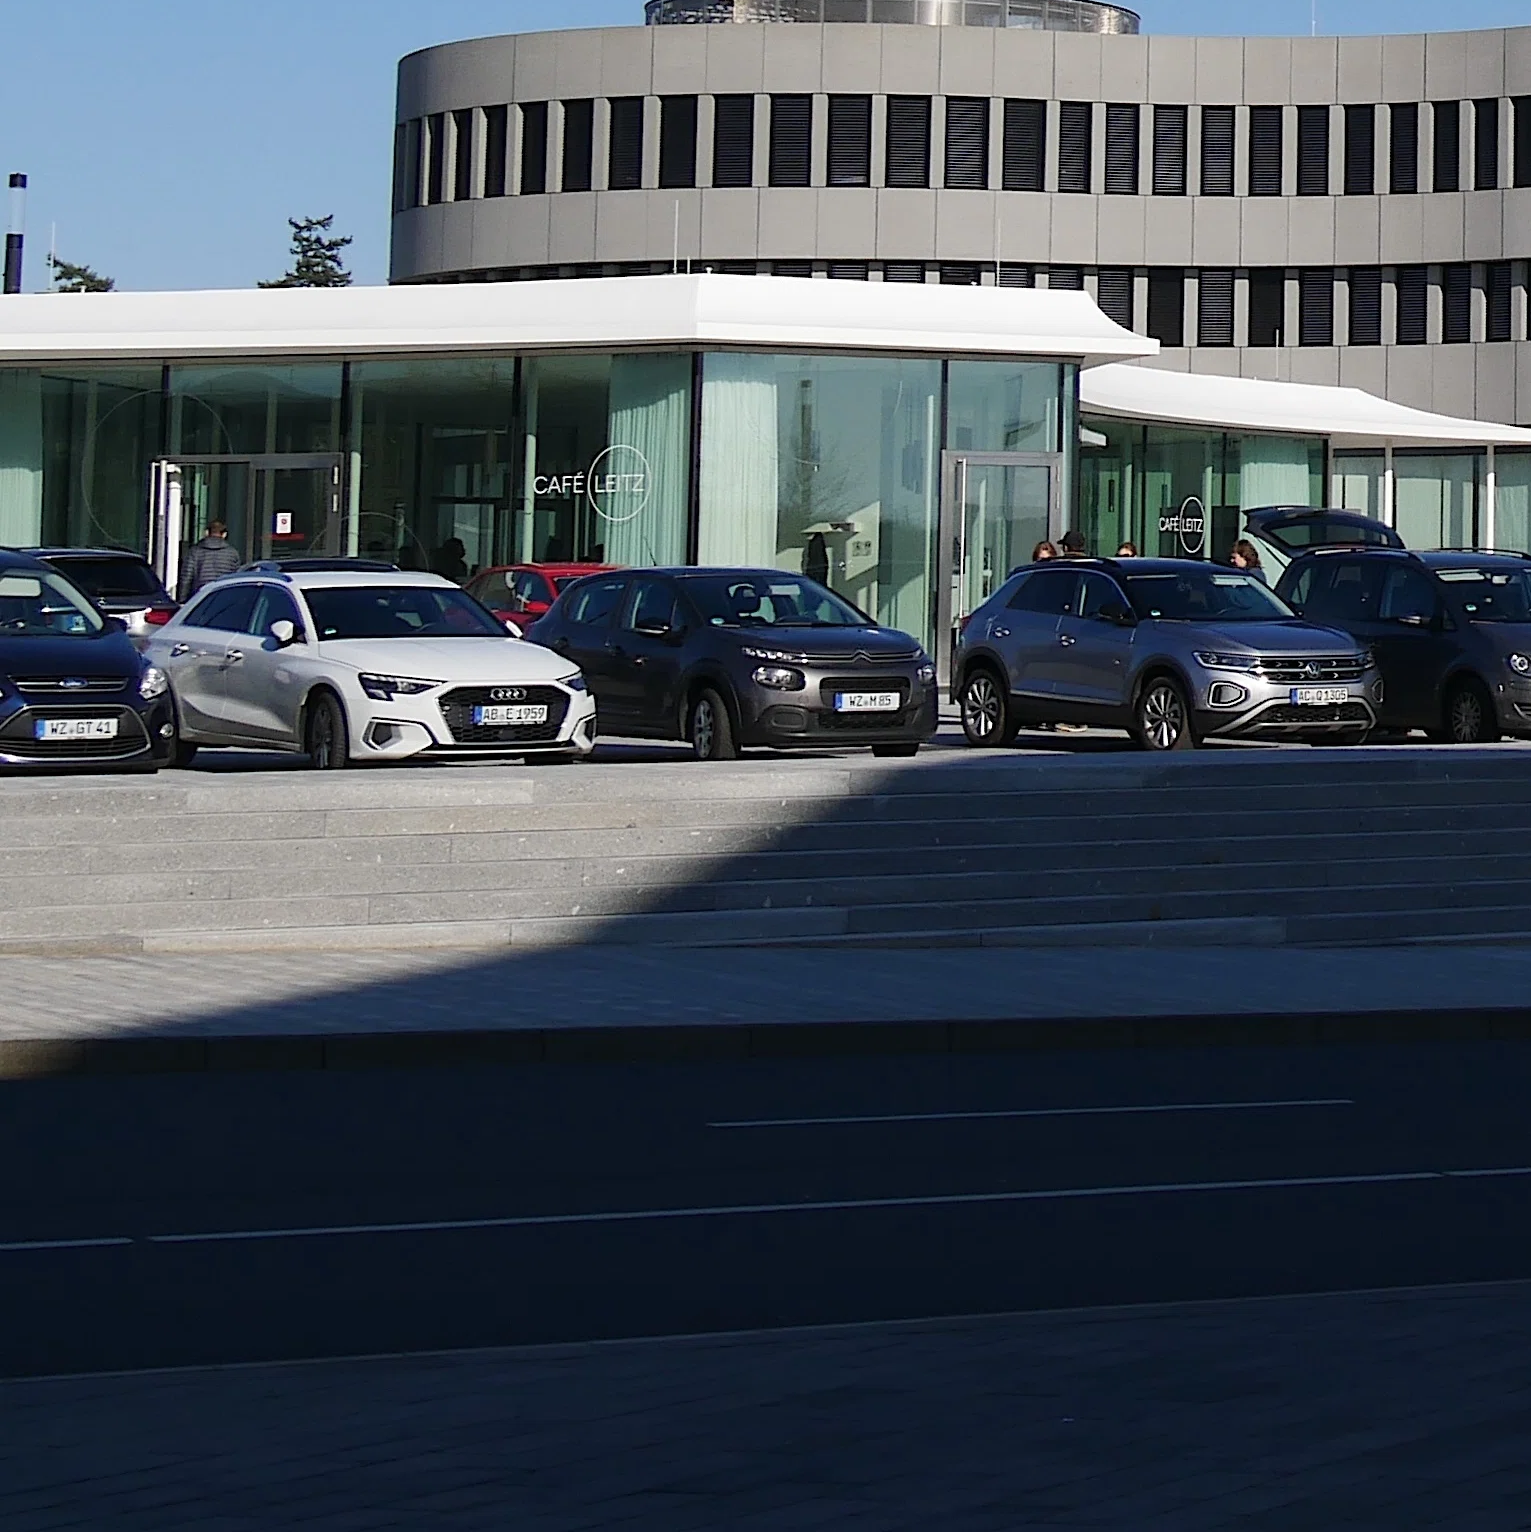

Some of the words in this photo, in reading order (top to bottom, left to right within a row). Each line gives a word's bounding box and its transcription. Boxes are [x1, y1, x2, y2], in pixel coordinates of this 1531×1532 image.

[533, 471, 585, 494] CAFÉ
[594, 474, 645, 493] LEITZ
[1159, 515, 1180, 531] CAFÉ
[1182, 518, 1203, 532] LEITZ
